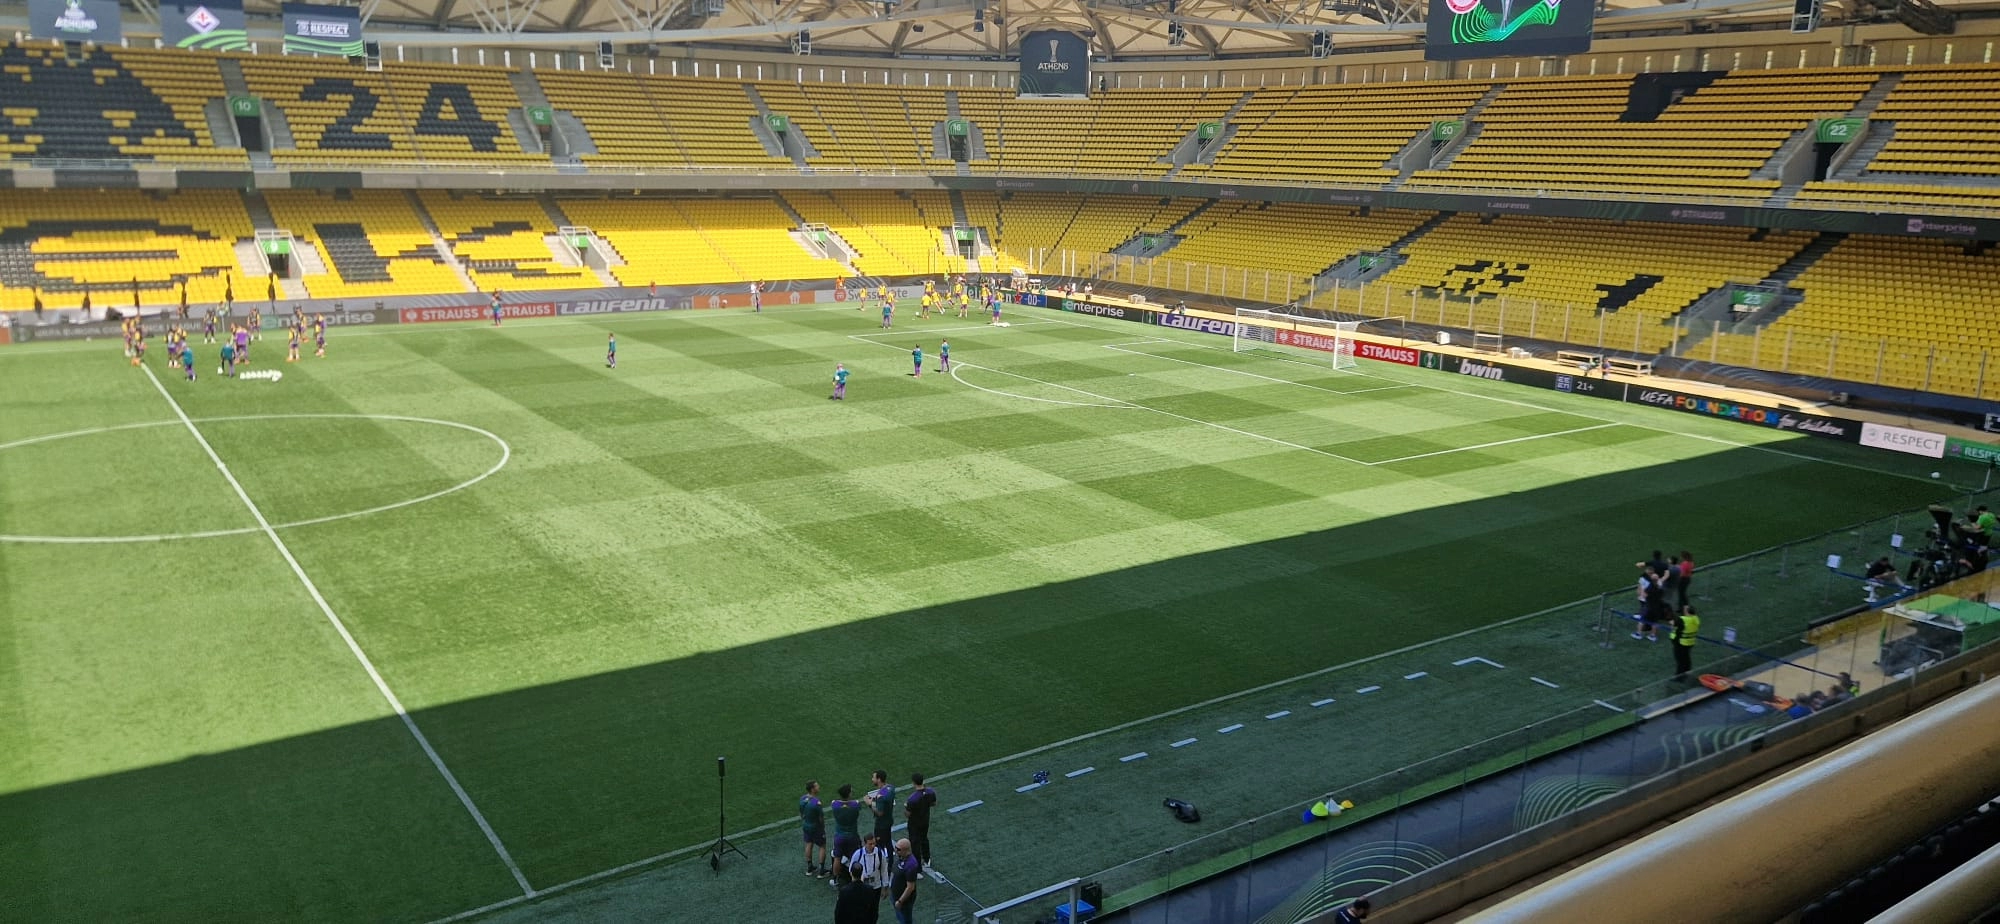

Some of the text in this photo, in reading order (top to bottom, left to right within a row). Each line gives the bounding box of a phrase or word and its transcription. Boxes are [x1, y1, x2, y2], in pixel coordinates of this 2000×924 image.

[1038, 62, 1069, 71] ATHENS
[239, 100, 252, 112] 10
[535, 110, 545, 121] 12
[772, 118, 781, 127] 14
[1441, 126, 1453, 135] 20
[1830, 124, 1847, 136] 22
[422, 308, 479, 321] STRAUSS
[1065, 300, 1124, 318] enterprise
[1362, 344, 1415, 363] STRAUSS
[1459, 357, 1503, 380] bwin
[1576, 381, 1595, 391] 21+
[1639, 390, 1674, 406] UEFA
[1675, 395, 1779, 425] FOUNDATION
[1883, 431, 1942, 451] RESPECT
